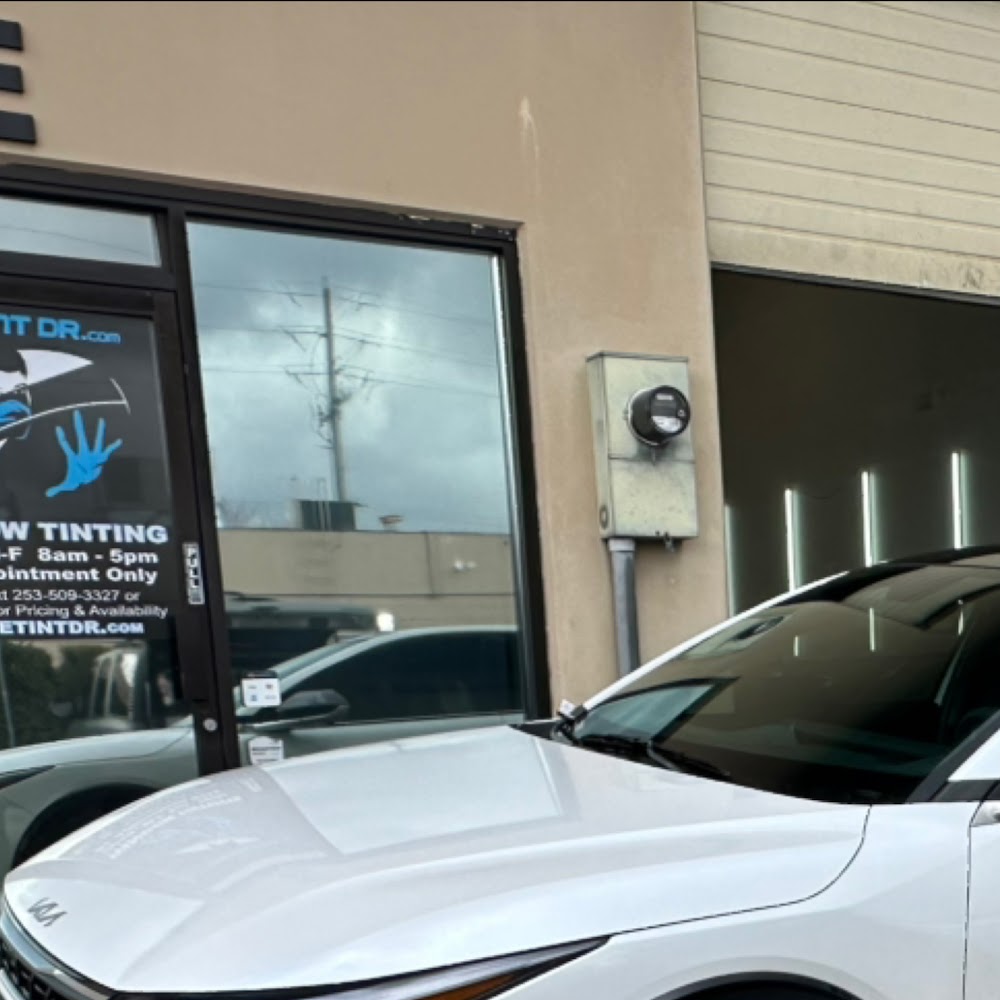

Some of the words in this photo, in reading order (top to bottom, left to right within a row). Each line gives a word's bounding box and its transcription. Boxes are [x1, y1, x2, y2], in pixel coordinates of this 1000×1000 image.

[37, 522, 168, 544] TINTING
[37, 547, 89, 562] 8am
[109, 548, 159, 566] 5pm
[106, 567, 158, 585] Only
[186, 547, 201, 589] PULL
[12, 589, 120, 601] 253-509-3327
[124, 591, 141, 601] or
[15, 604, 69, 619] Pricing
[74, 604, 86, 616] &
[89, 604, 168, 619] Availability
